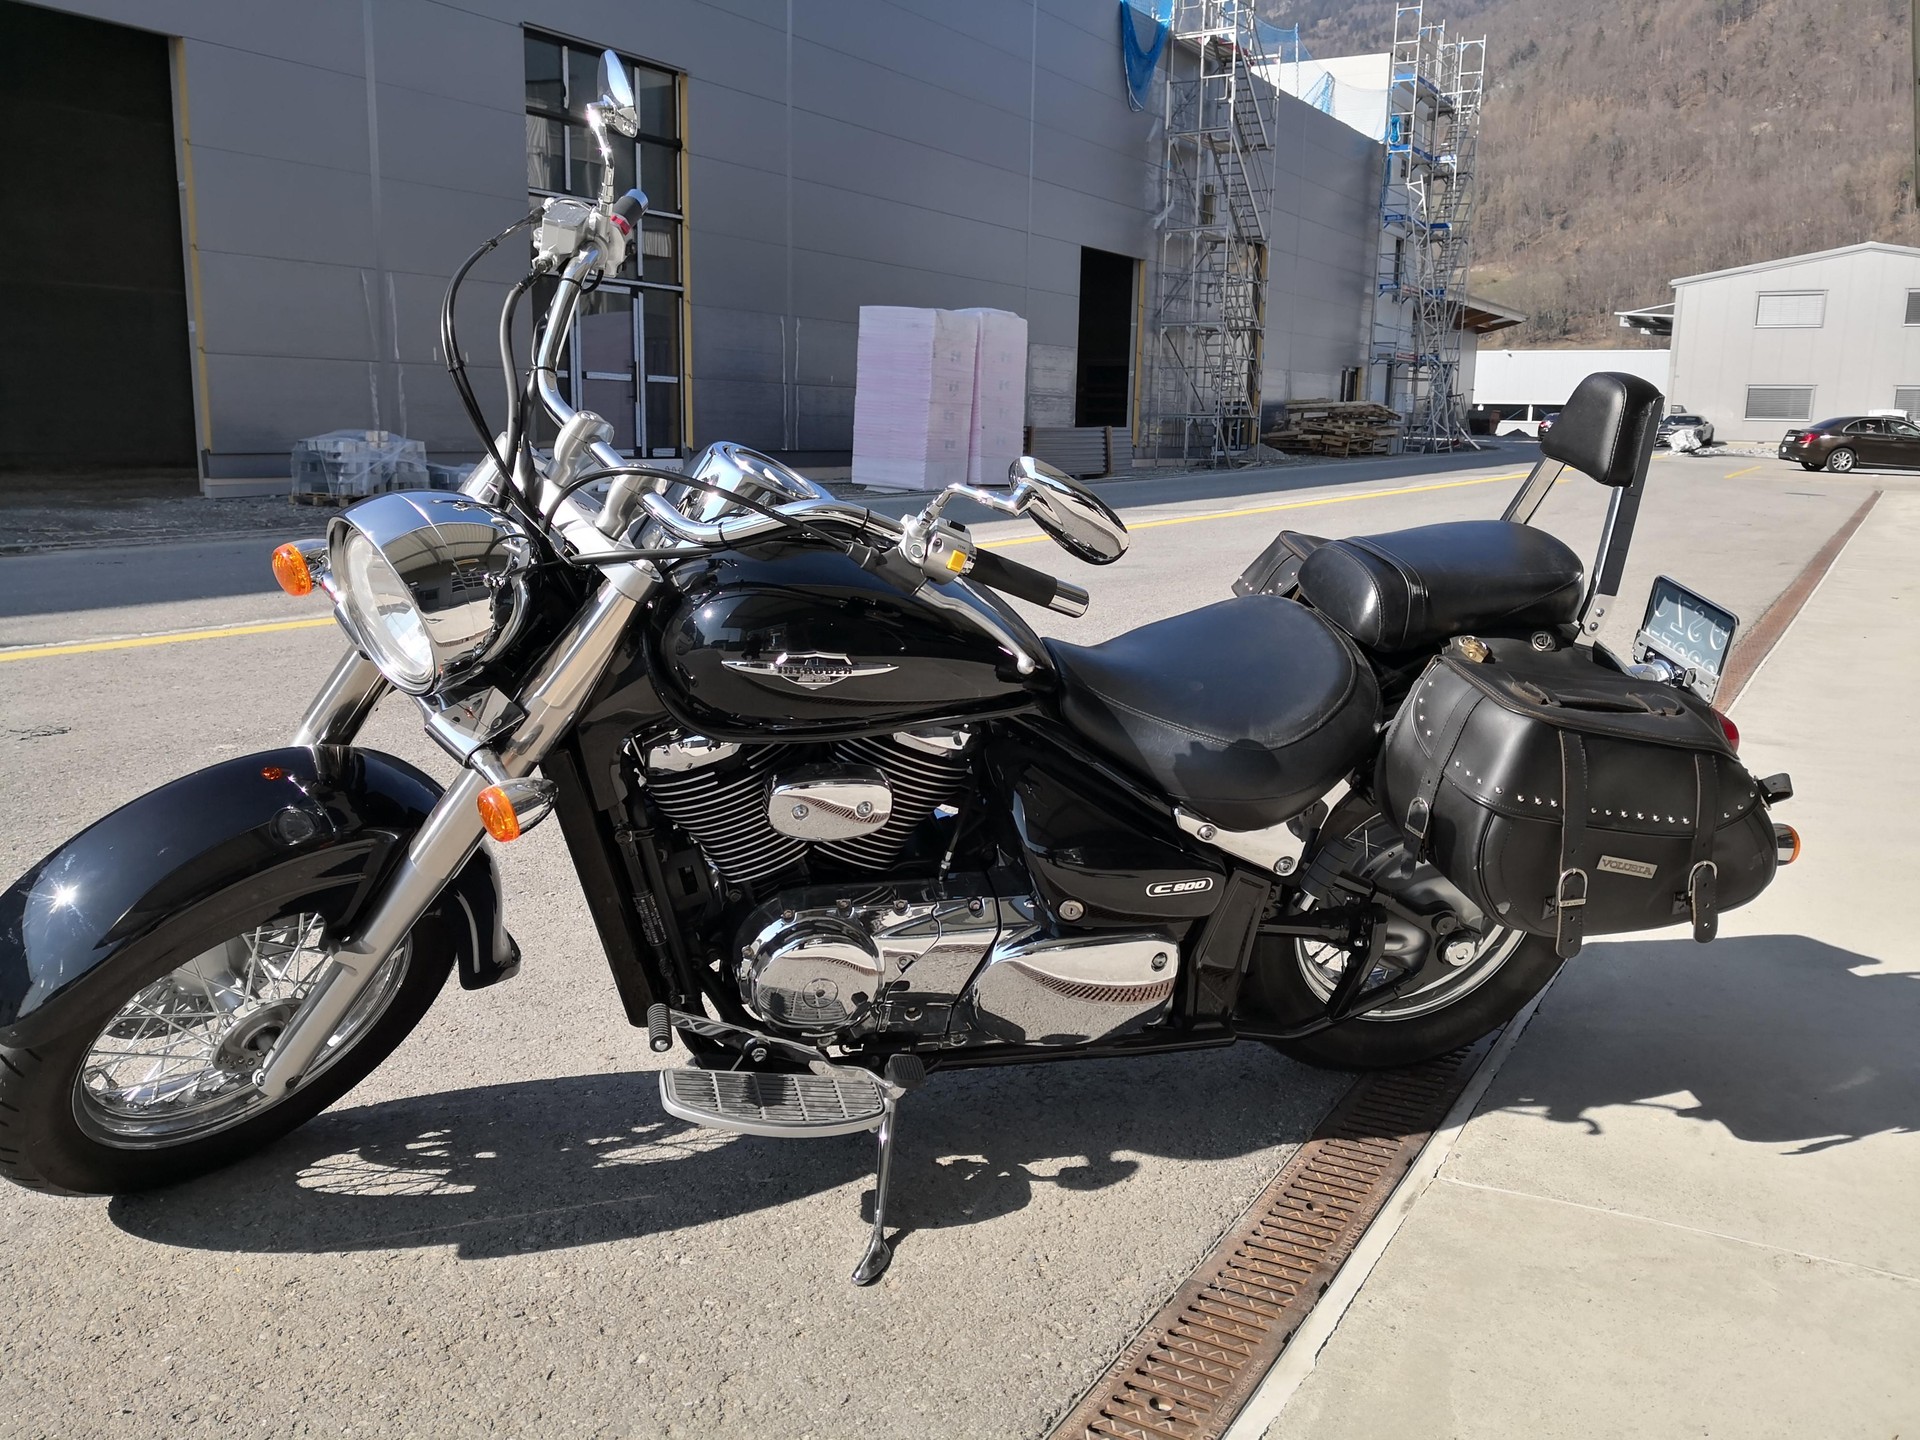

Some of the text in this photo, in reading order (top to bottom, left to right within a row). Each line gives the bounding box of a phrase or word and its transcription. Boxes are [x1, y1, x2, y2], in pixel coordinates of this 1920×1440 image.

[777, 665, 852, 676] INTRUDER
[1602, 858, 1653, 876] VOLUSIA
[1153, 880, 1207, 893] C 800
